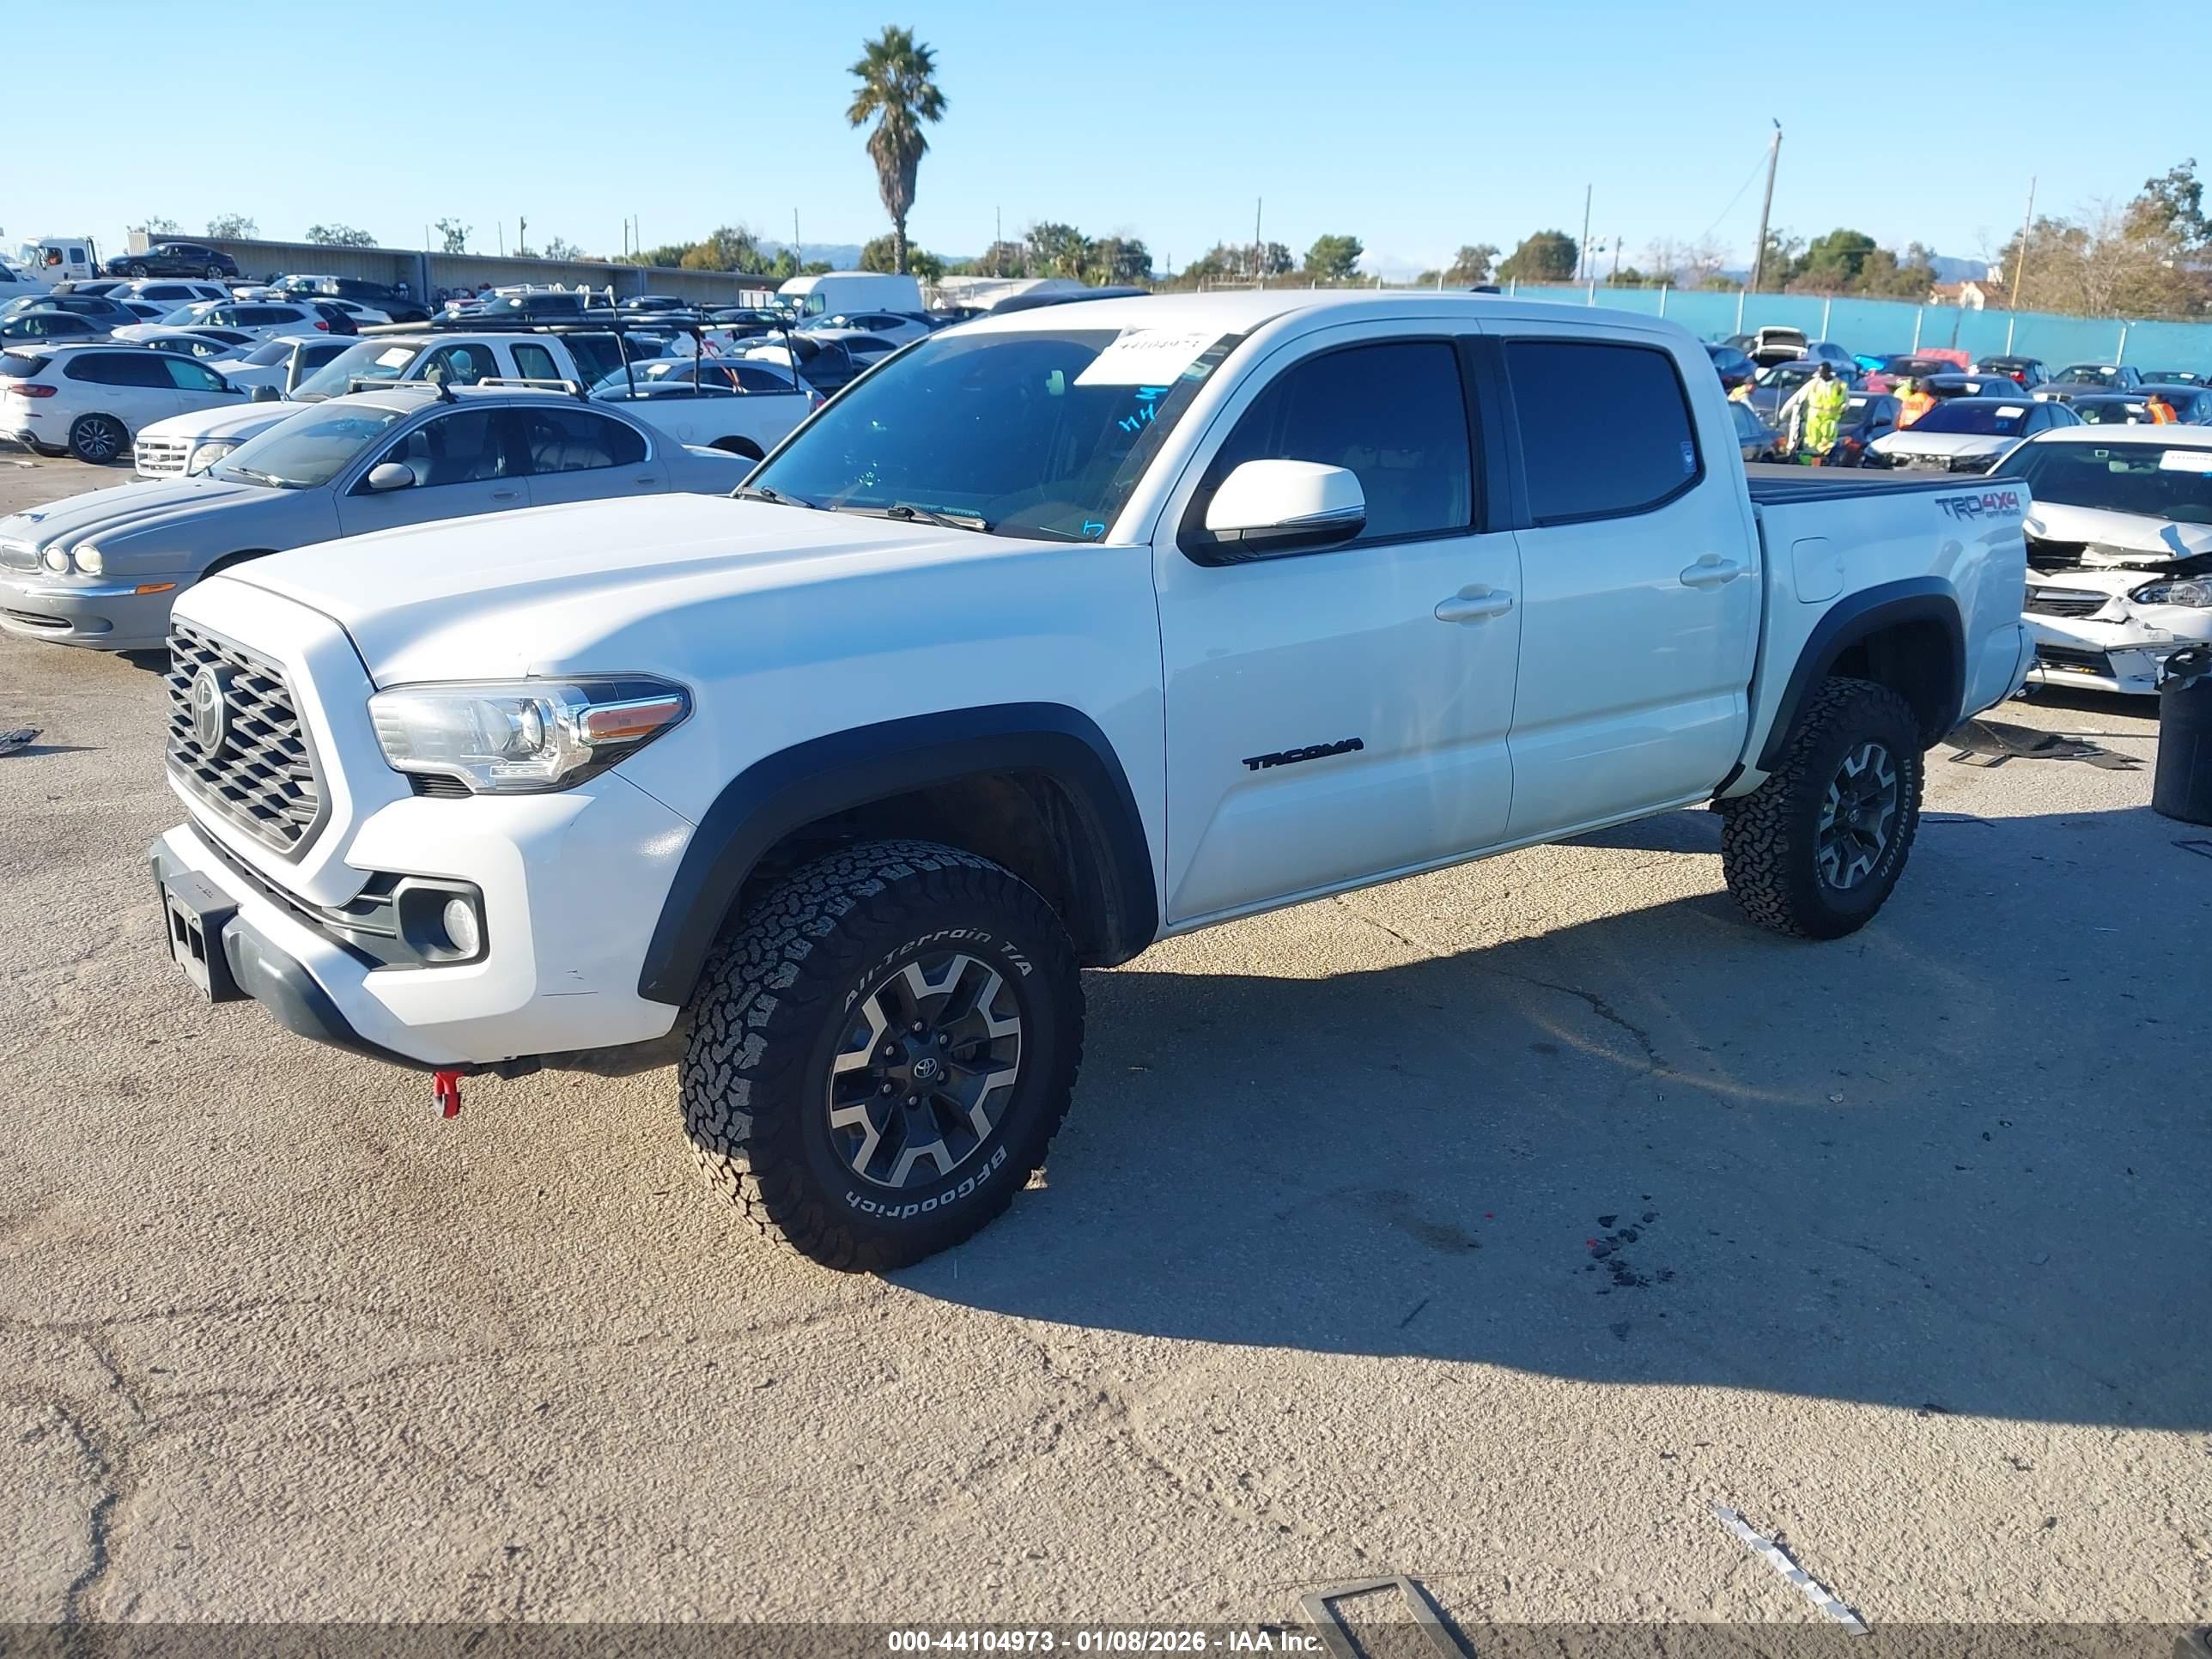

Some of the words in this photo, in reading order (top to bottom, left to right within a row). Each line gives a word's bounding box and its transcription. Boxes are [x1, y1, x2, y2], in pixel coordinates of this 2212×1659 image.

[1242, 737, 1364, 771] TACOMA
[844, 927, 993, 1013] All-Terrain
[845, 1146, 1008, 1219] BFGoodrich
